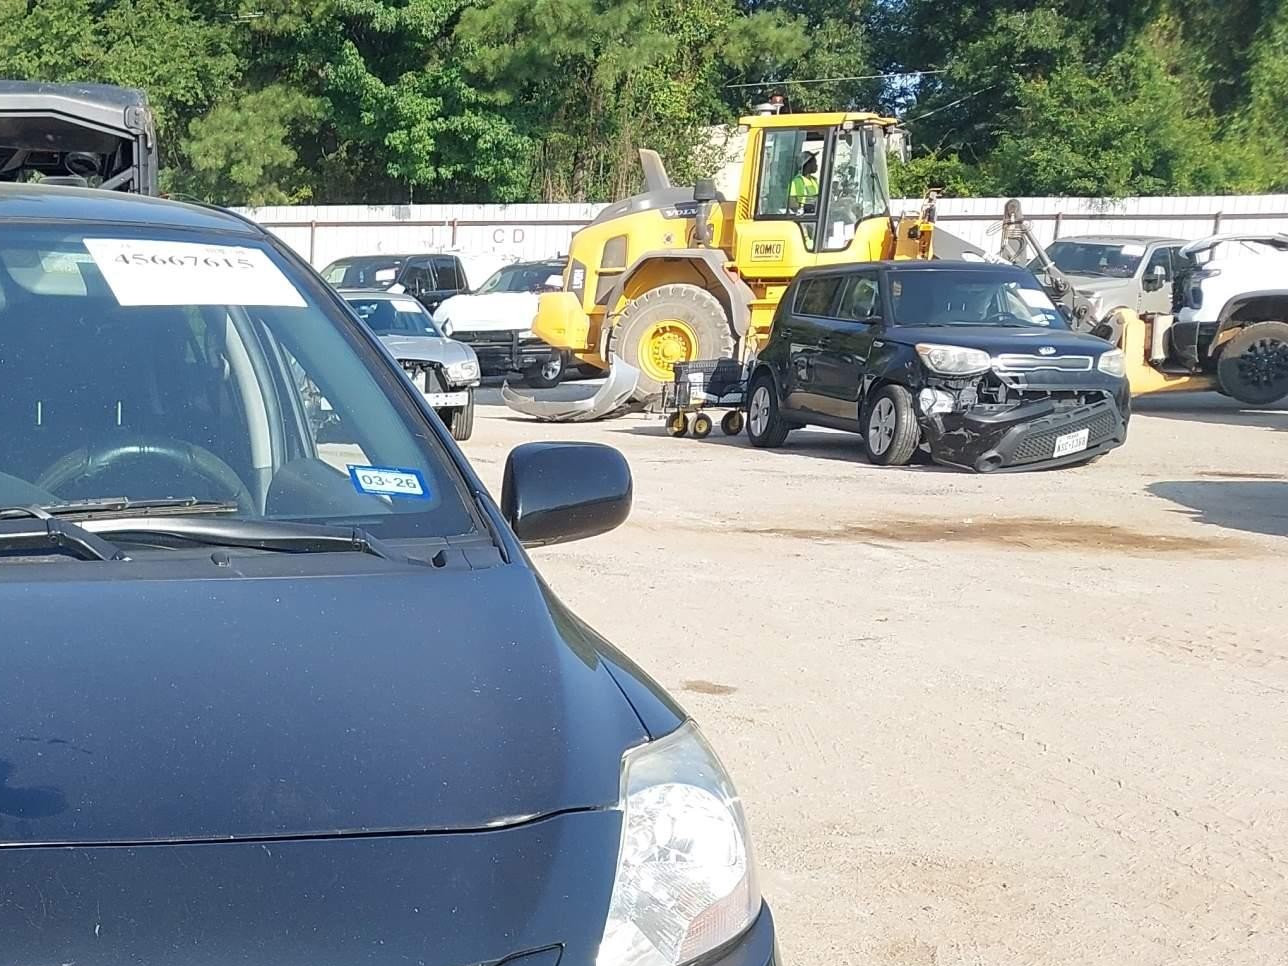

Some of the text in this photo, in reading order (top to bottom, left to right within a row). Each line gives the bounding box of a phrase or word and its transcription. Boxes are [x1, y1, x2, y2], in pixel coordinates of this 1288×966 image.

[666, 208, 698, 217] VOLV
[754, 243, 782, 255] ROMCO
[114, 253, 255, 269] 45667615
